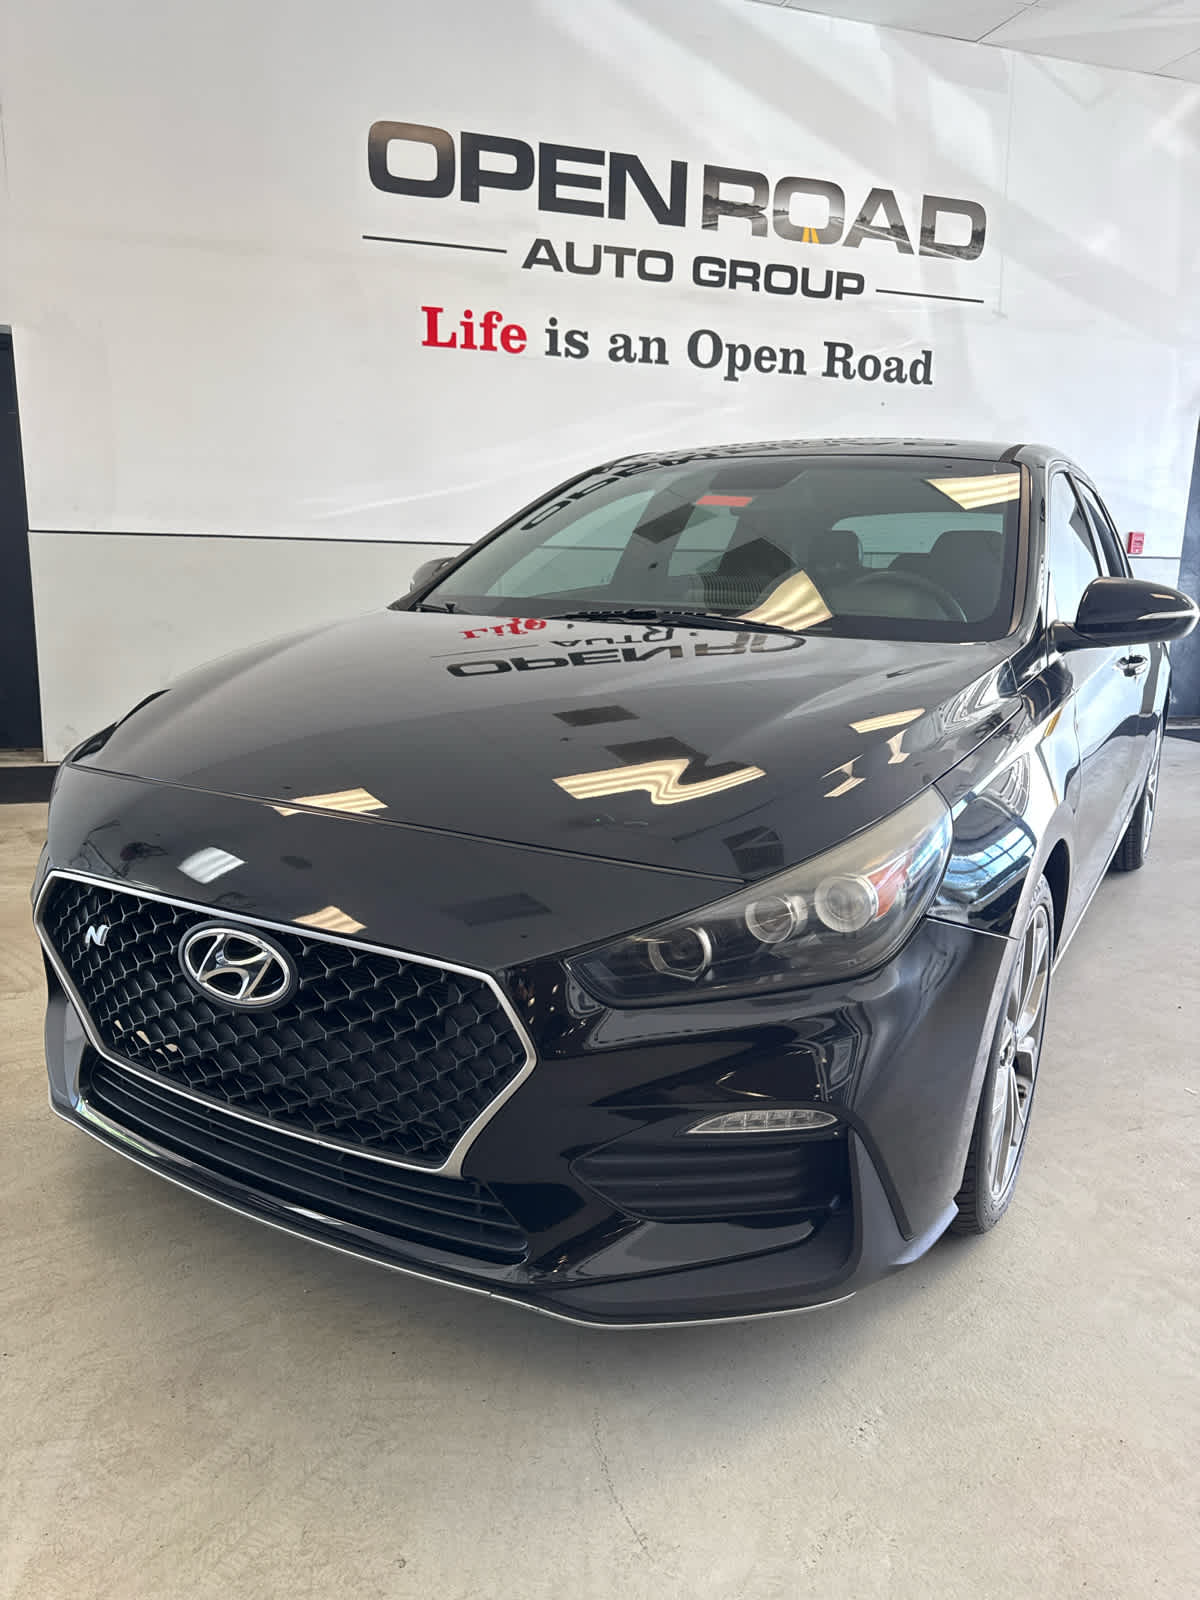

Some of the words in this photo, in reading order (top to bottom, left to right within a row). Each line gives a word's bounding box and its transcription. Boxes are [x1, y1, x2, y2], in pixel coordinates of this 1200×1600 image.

[368, 121, 688, 228] OPEN
[702, 165, 987, 261] ROAD
[522, 238, 673, 283] AUTO
[693, 256, 865, 301] GROUP
[421, 306, 528, 355] Life
[544, 316, 590, 360] is
[608, 333, 669, 369] an
[687, 329, 807, 382] Open
[822, 341, 933, 386] Road
